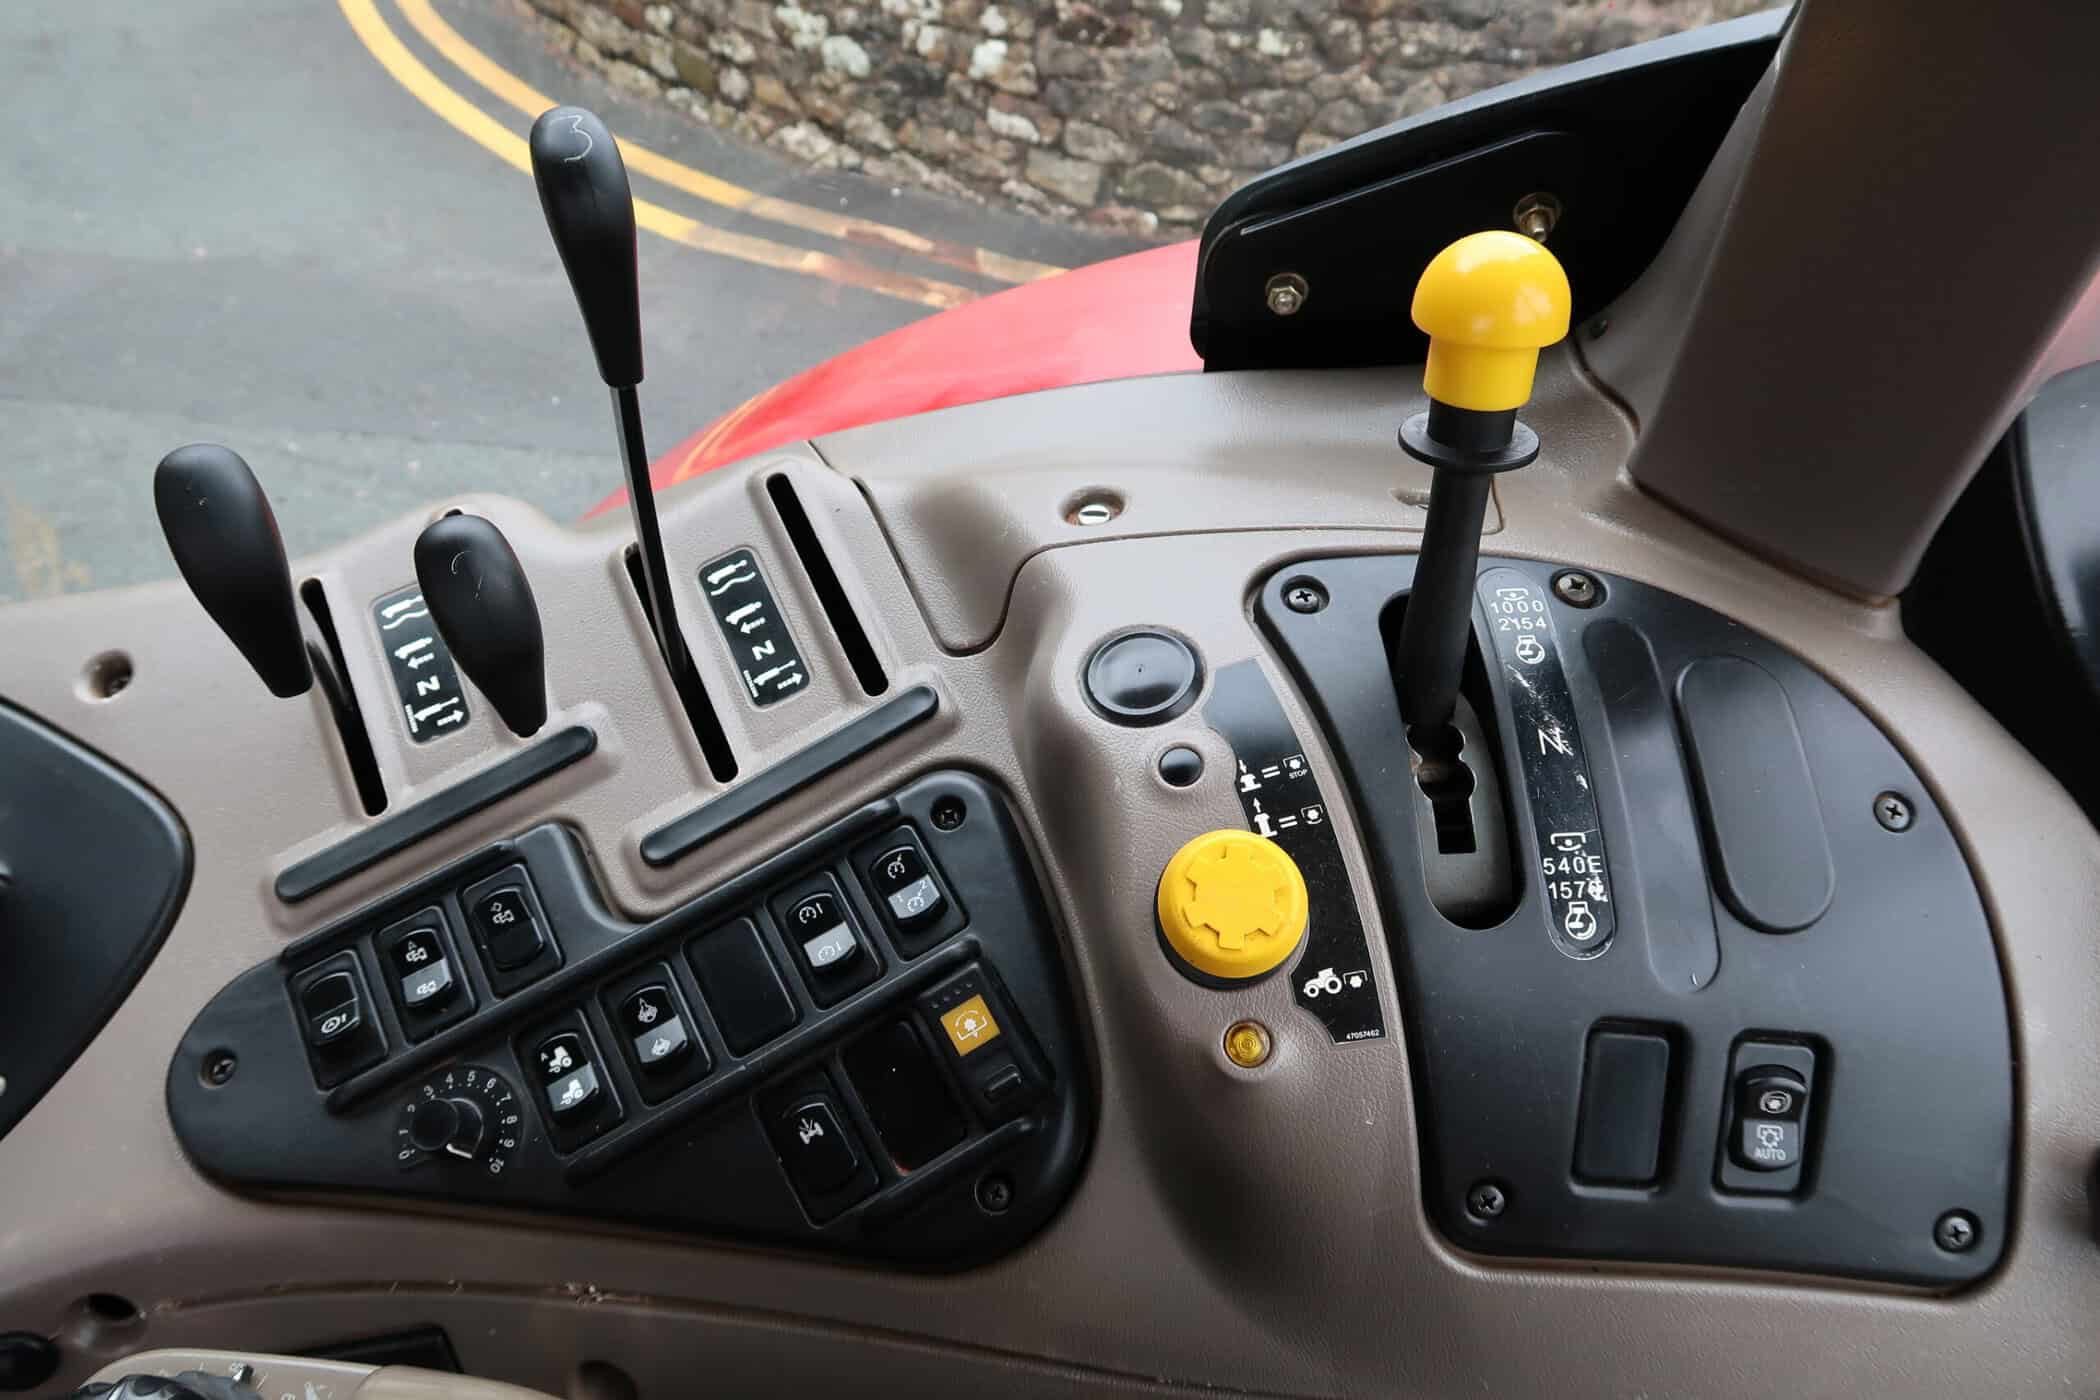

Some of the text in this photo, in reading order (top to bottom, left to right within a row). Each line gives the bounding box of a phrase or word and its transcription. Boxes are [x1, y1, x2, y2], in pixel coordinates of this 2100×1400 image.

[1490, 600, 1544, 614] 1000
[1498, 616, 1547, 631] 2154
[752, 639, 776, 661] N
[416, 674, 440, 696] N
[1537, 727, 1564, 755] N
[1289, 768, 1308, 779] STOP
[1543, 855, 1604, 876] 540E
[445, 1073, 454, 1084] 4
[467, 1071, 476, 1082] 5
[487, 1077, 497, 1089] 6
[423, 1085, 434, 1096] 3
[501, 1092, 512, 1101] 7
[506, 1115, 518, 1124] 8
[504, 1138, 515, 1148] 9
[398, 1149, 410, 1160] 0
[1754, 1146, 1786, 1161] AUTO
